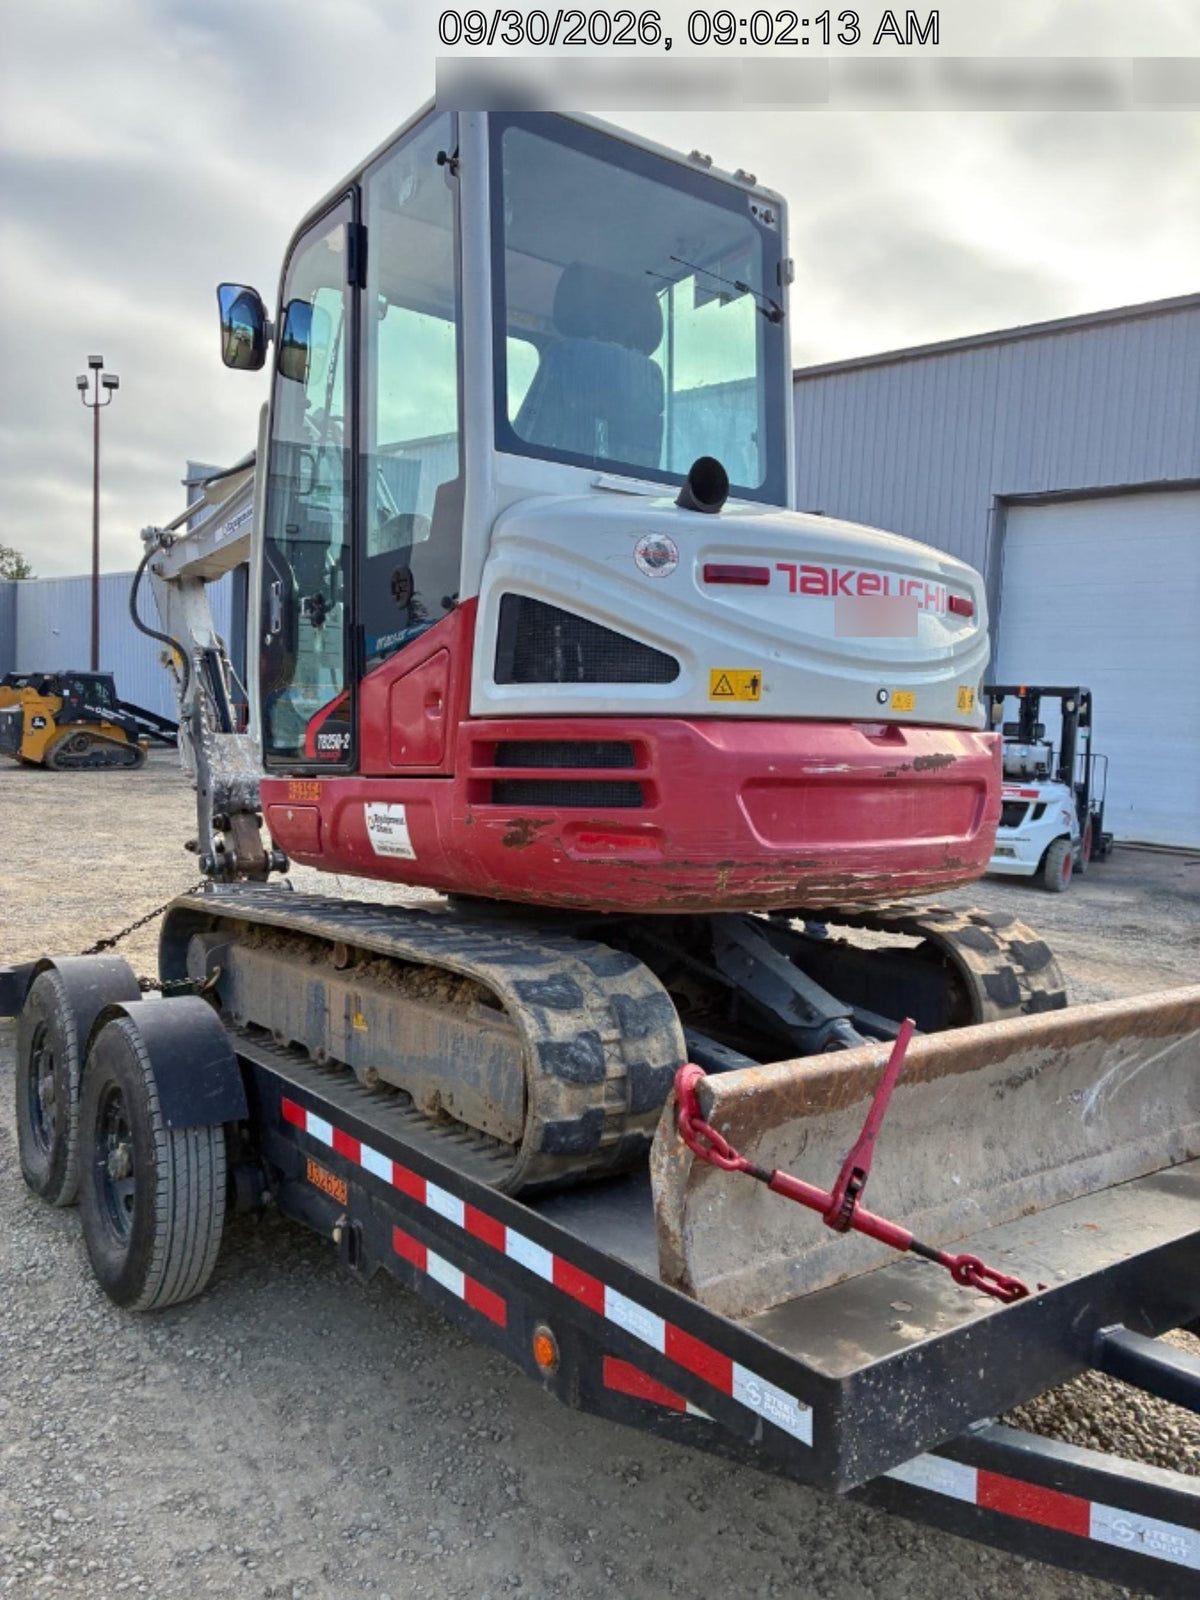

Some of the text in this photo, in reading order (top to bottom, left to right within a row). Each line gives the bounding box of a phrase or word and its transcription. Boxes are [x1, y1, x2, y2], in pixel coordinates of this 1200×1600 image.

[317, 732, 351, 750] TB250-2
[764, 1391, 798, 1419] STEEL
[764, 1401, 799, 1427] POINT
